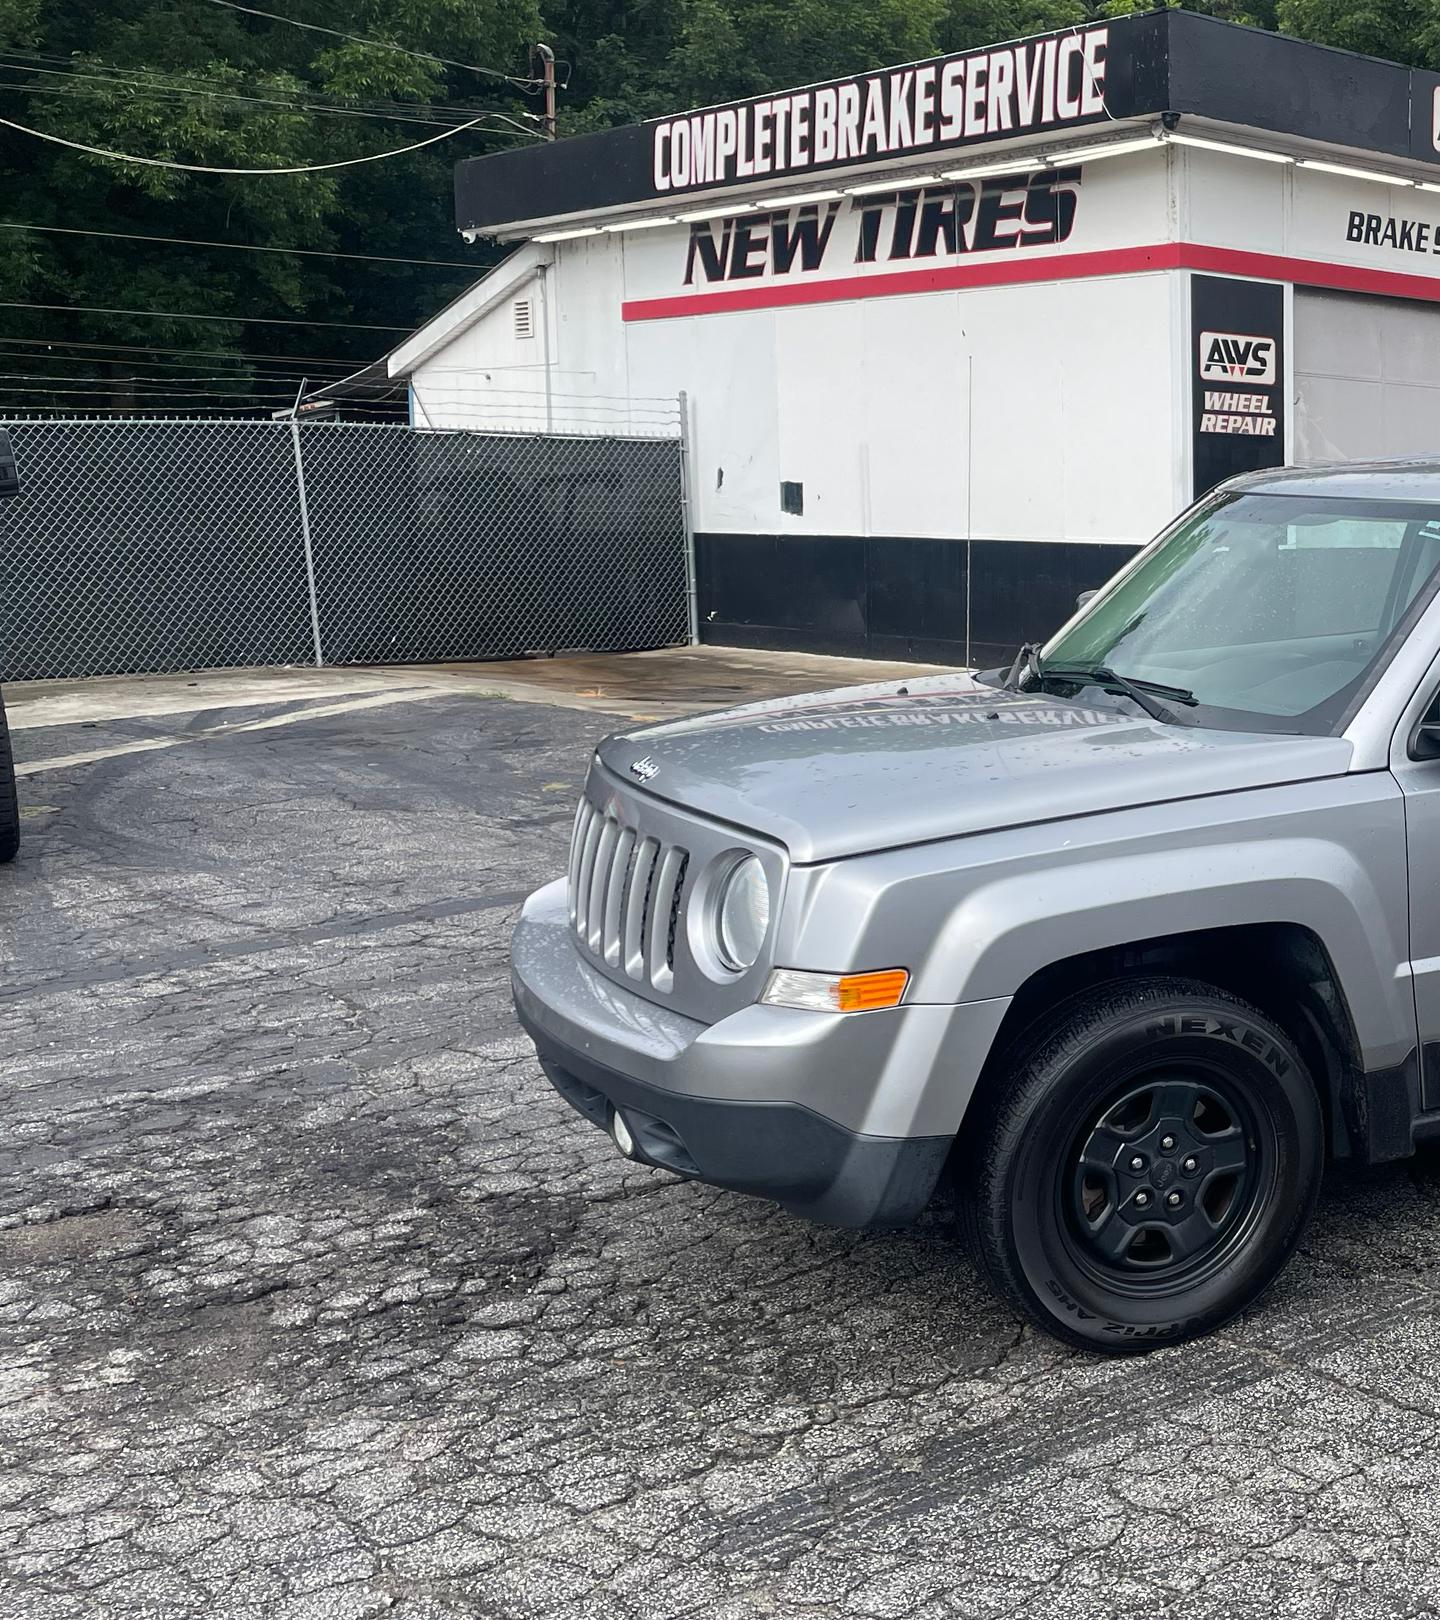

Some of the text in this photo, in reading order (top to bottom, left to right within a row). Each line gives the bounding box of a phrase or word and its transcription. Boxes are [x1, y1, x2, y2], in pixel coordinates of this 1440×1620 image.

[654, 28, 1108, 190] COMPLETE BRAKE SERVICE
[683, 165, 1084, 286] NEW TIRES
[1345, 211, 1431, 253] BRAKE
[1204, 338, 1272, 377] AWS
[1204, 391, 1272, 414] WHEEL
[1200, 413, 1276, 436] REPAIR
[1146, 1016, 1290, 1078] NEXEN
